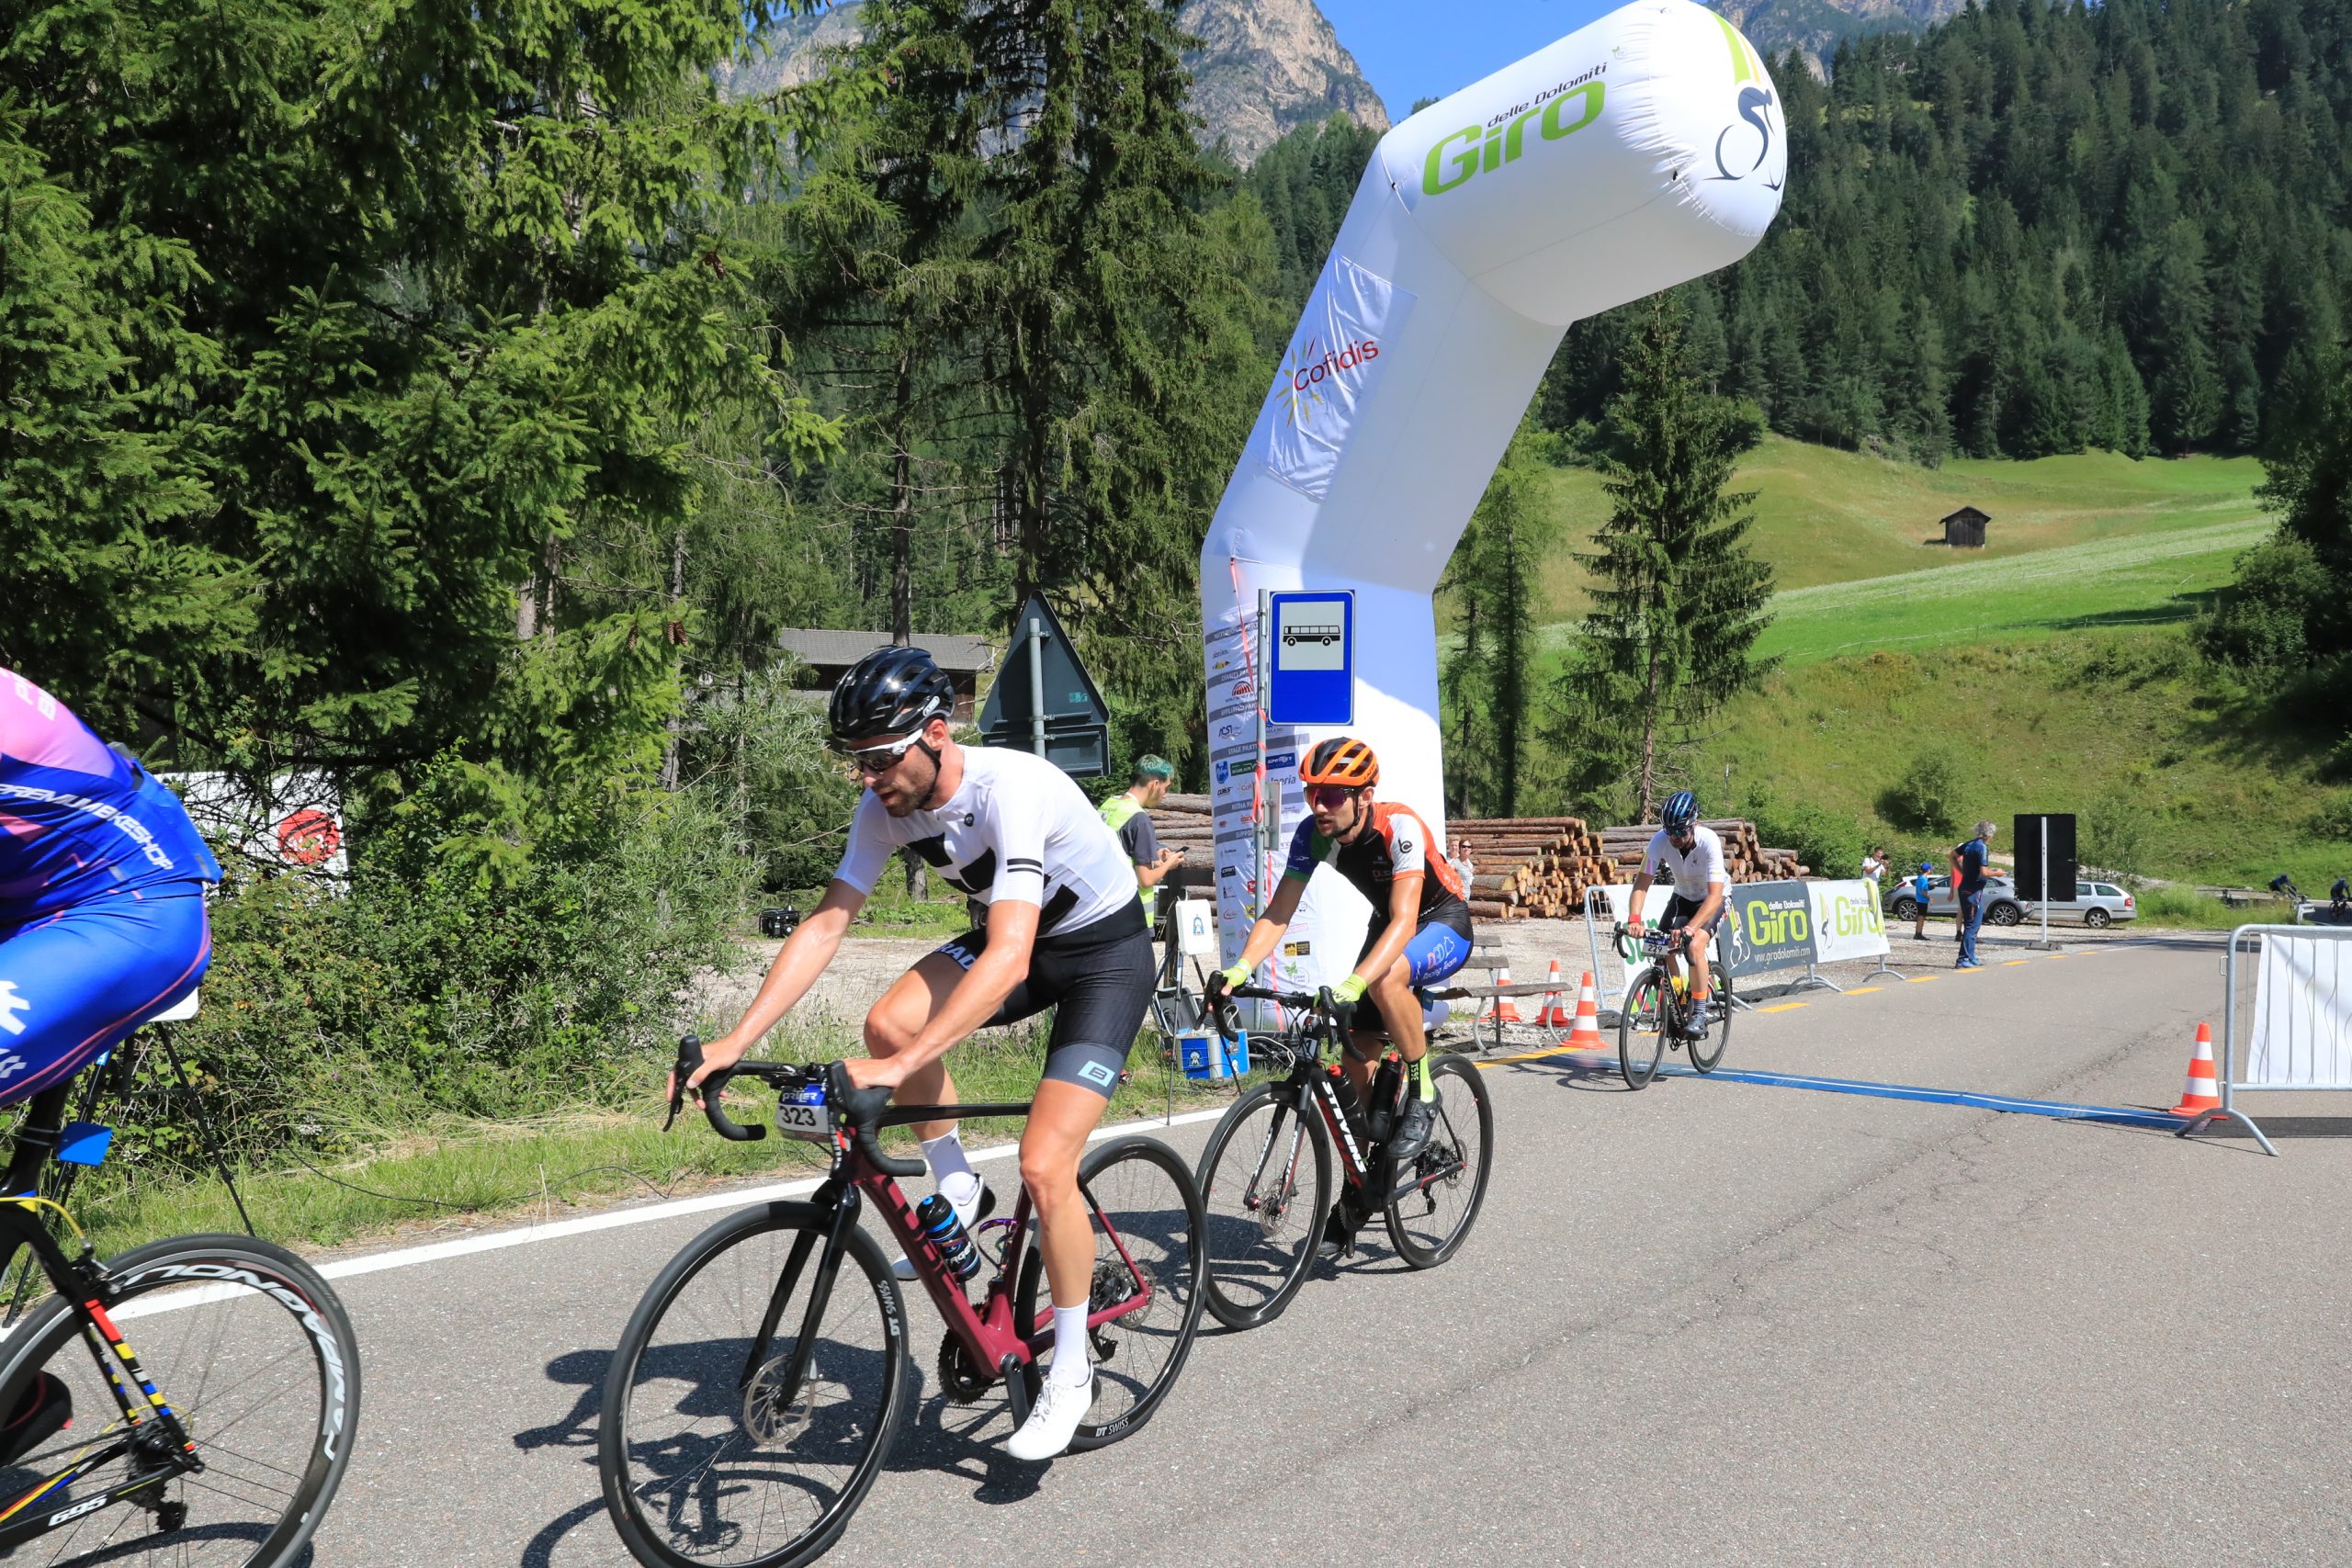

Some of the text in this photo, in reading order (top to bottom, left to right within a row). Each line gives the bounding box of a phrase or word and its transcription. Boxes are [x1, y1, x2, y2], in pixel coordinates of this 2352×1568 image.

[1487, 62, 1608, 128] delle Dolomiti
[1422, 80, 1606, 196] Giro
[1294, 339, 1379, 392] Cofidis
[1747, 900, 1808, 946] Giro
[779, 1105, 817, 1126] 323
[1322, 1081, 1367, 1173] STEVENS
[877, 1280, 897, 1314] SWISS
[1095, 1416, 1129, 1438] DT SWISS
[48, 1494, 107, 1527] 695
